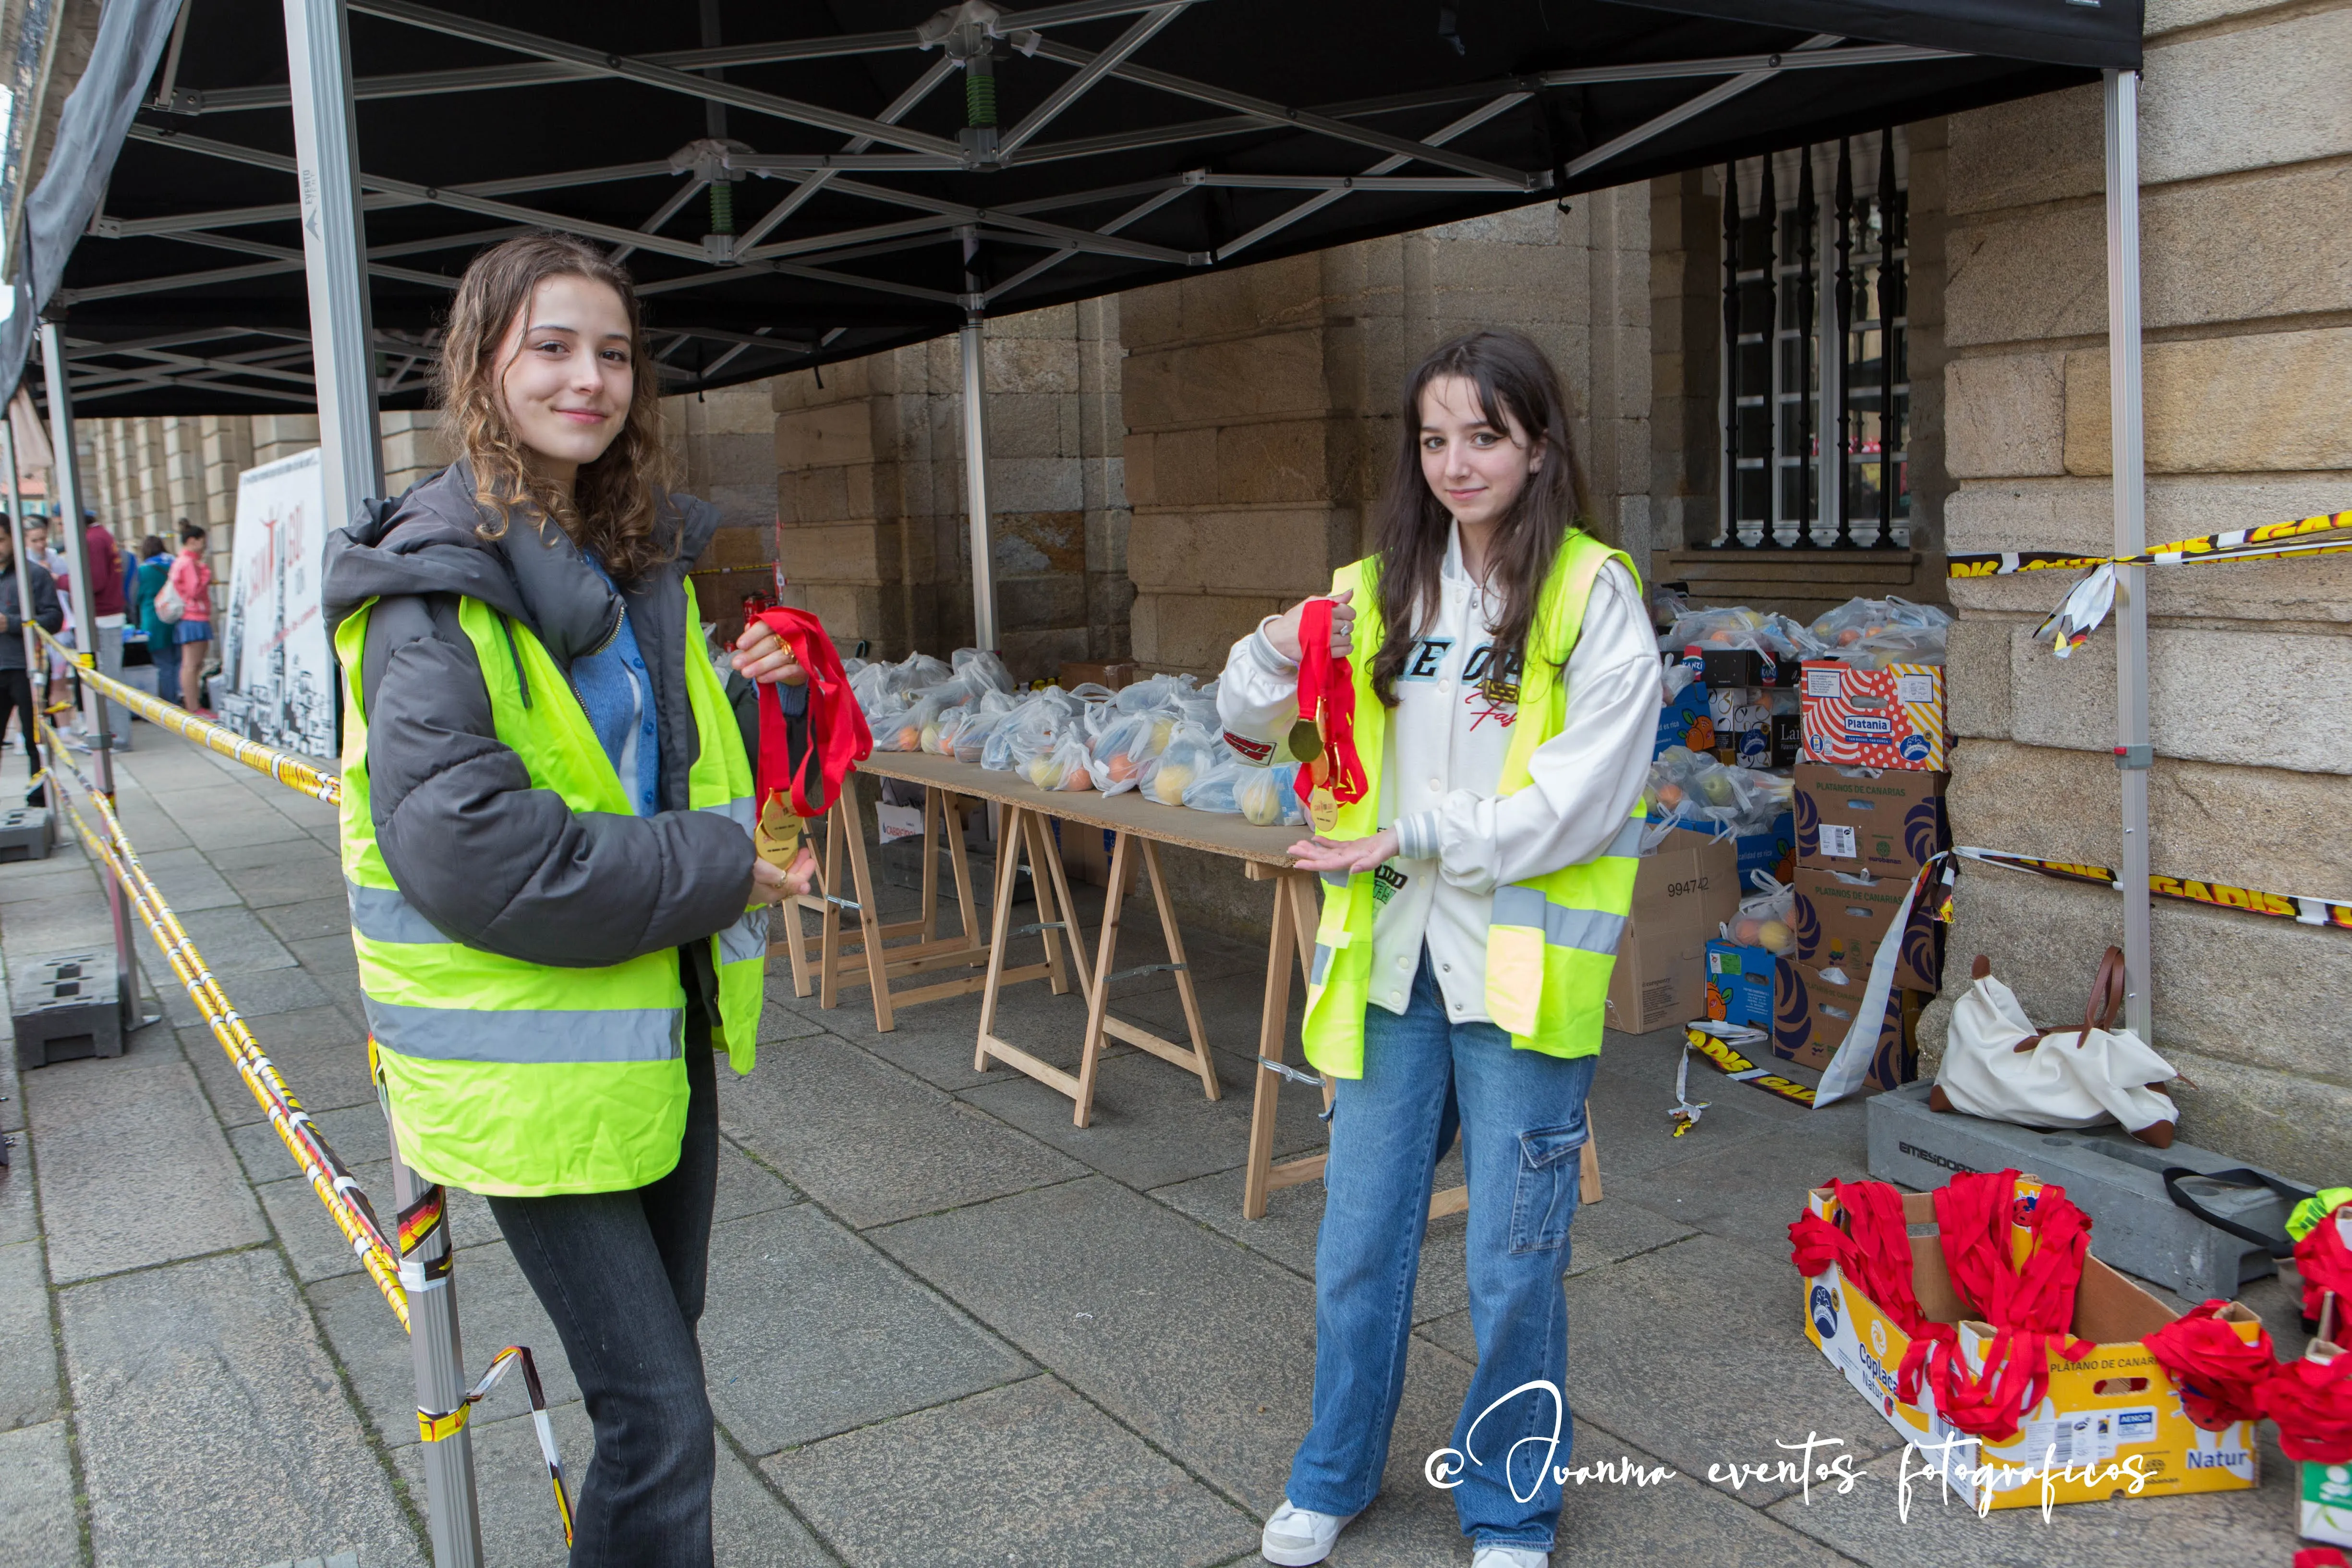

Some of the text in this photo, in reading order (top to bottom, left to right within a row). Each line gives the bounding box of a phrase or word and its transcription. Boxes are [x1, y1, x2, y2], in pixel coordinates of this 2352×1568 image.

[1848, 719, 1888, 730] Platania
[1866, 787, 1906, 796] CANARIAS
[1738, 851, 1756, 860] calidad
[1668, 877, 1709, 897] 994742
[1853, 891, 1863, 900] DE
[1864, 892, 1903, 905] CANARIAS
[2149, 875, 2296, 916] GADIS
[2101, 1360, 2115, 1369] DE
[1862, 1370, 1883, 1402] Natur
[2187, 1451, 2247, 1470] Natur
